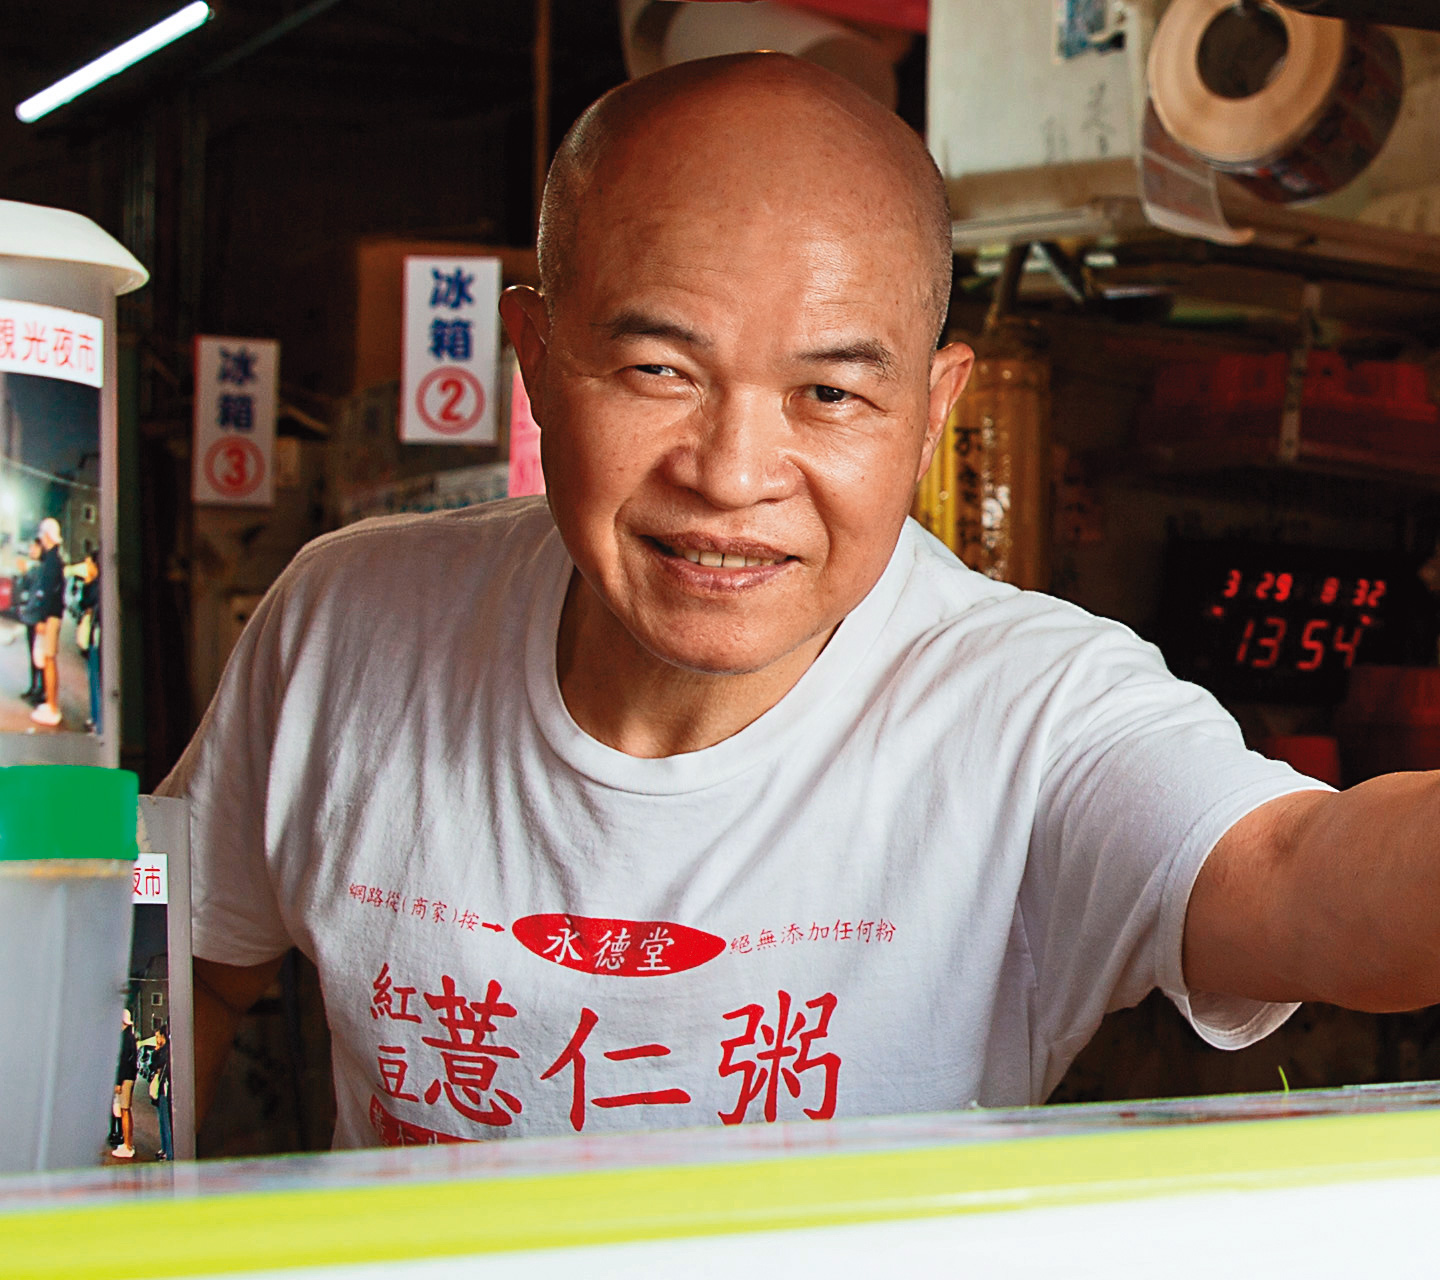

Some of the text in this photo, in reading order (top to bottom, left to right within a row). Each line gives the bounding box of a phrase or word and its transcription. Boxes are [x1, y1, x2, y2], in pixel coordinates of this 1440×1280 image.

[428, 266, 476, 366] 冰箱
[218, 348, 257, 432] 冰箱
[542, 918, 677, 974] 永德堂
[369, 962, 842, 1132] 紅豆 薏仁粥
